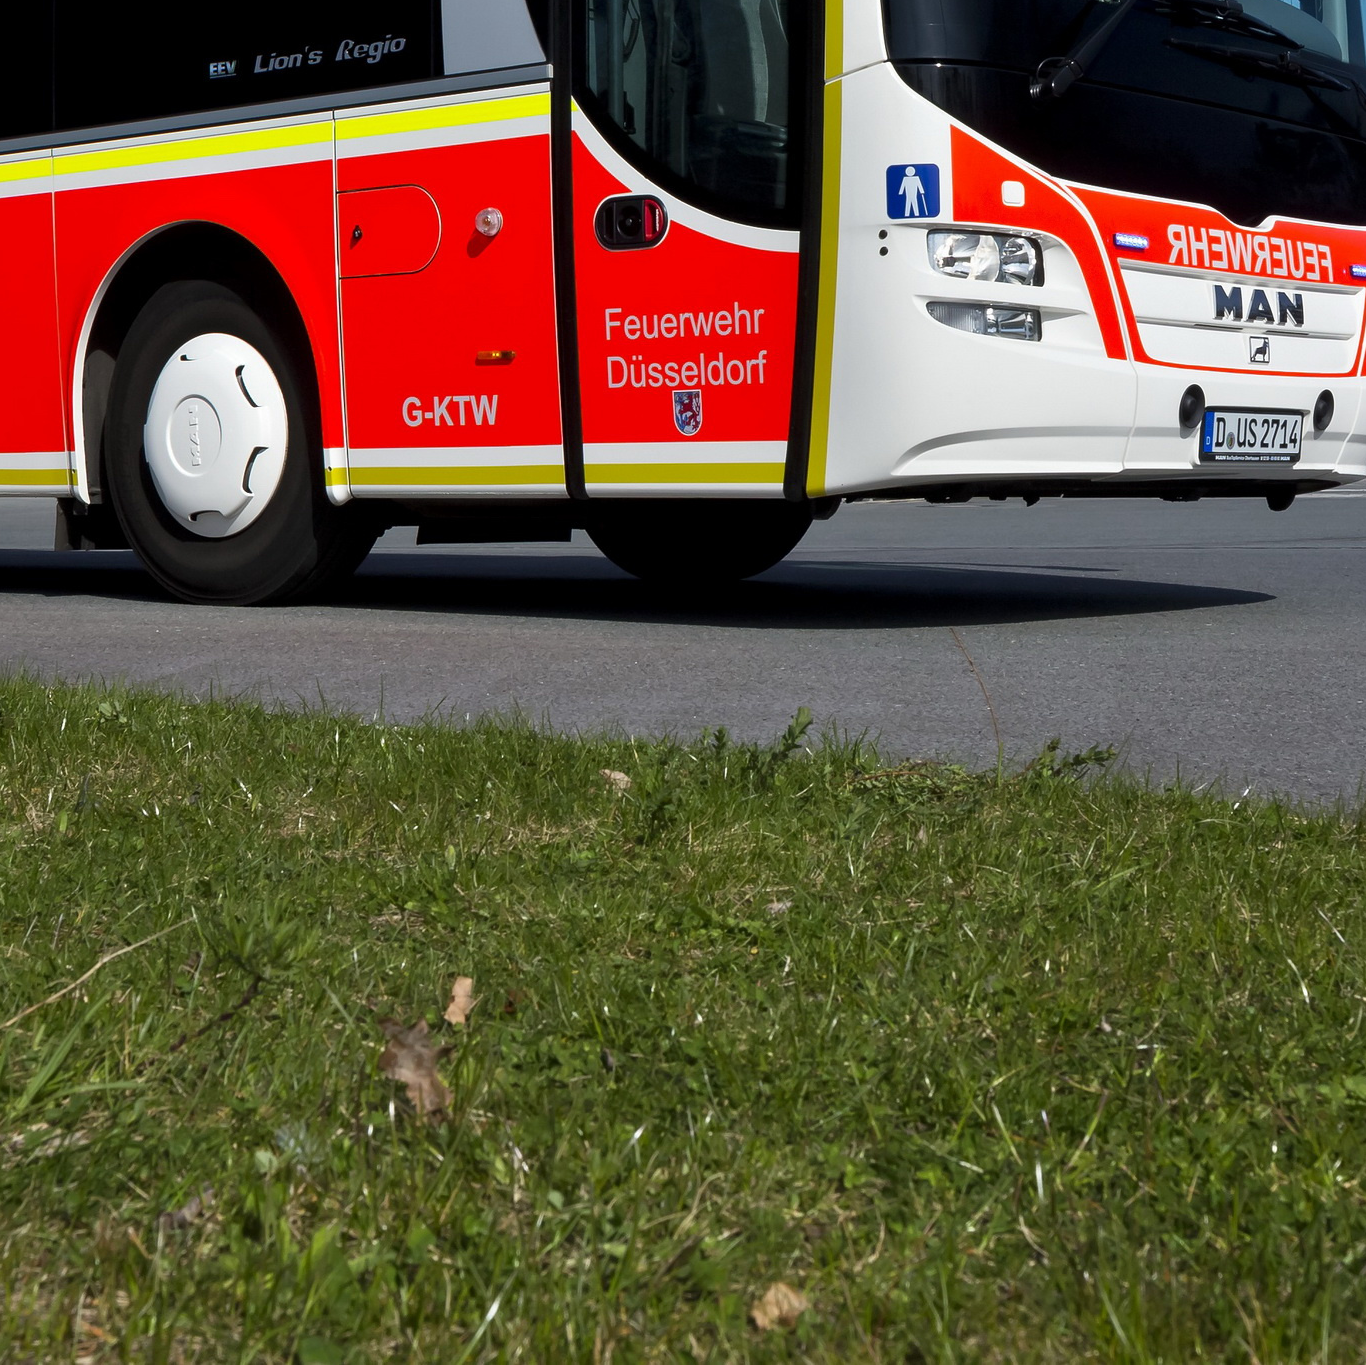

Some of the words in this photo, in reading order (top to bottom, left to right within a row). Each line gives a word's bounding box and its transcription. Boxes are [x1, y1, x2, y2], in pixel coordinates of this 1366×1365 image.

[209, 60, 237, 76] EEV
[254, 46, 323, 73] Lion's
[335, 34, 406, 64] Regio
[604, 302, 764, 340] Feuerwehr
[1212, 284, 1304, 327] MAN
[606, 350, 767, 389] Düsseldorf
[402, 394, 499, 427] G-KTW
[1260, 418, 1298, 449] 2714
